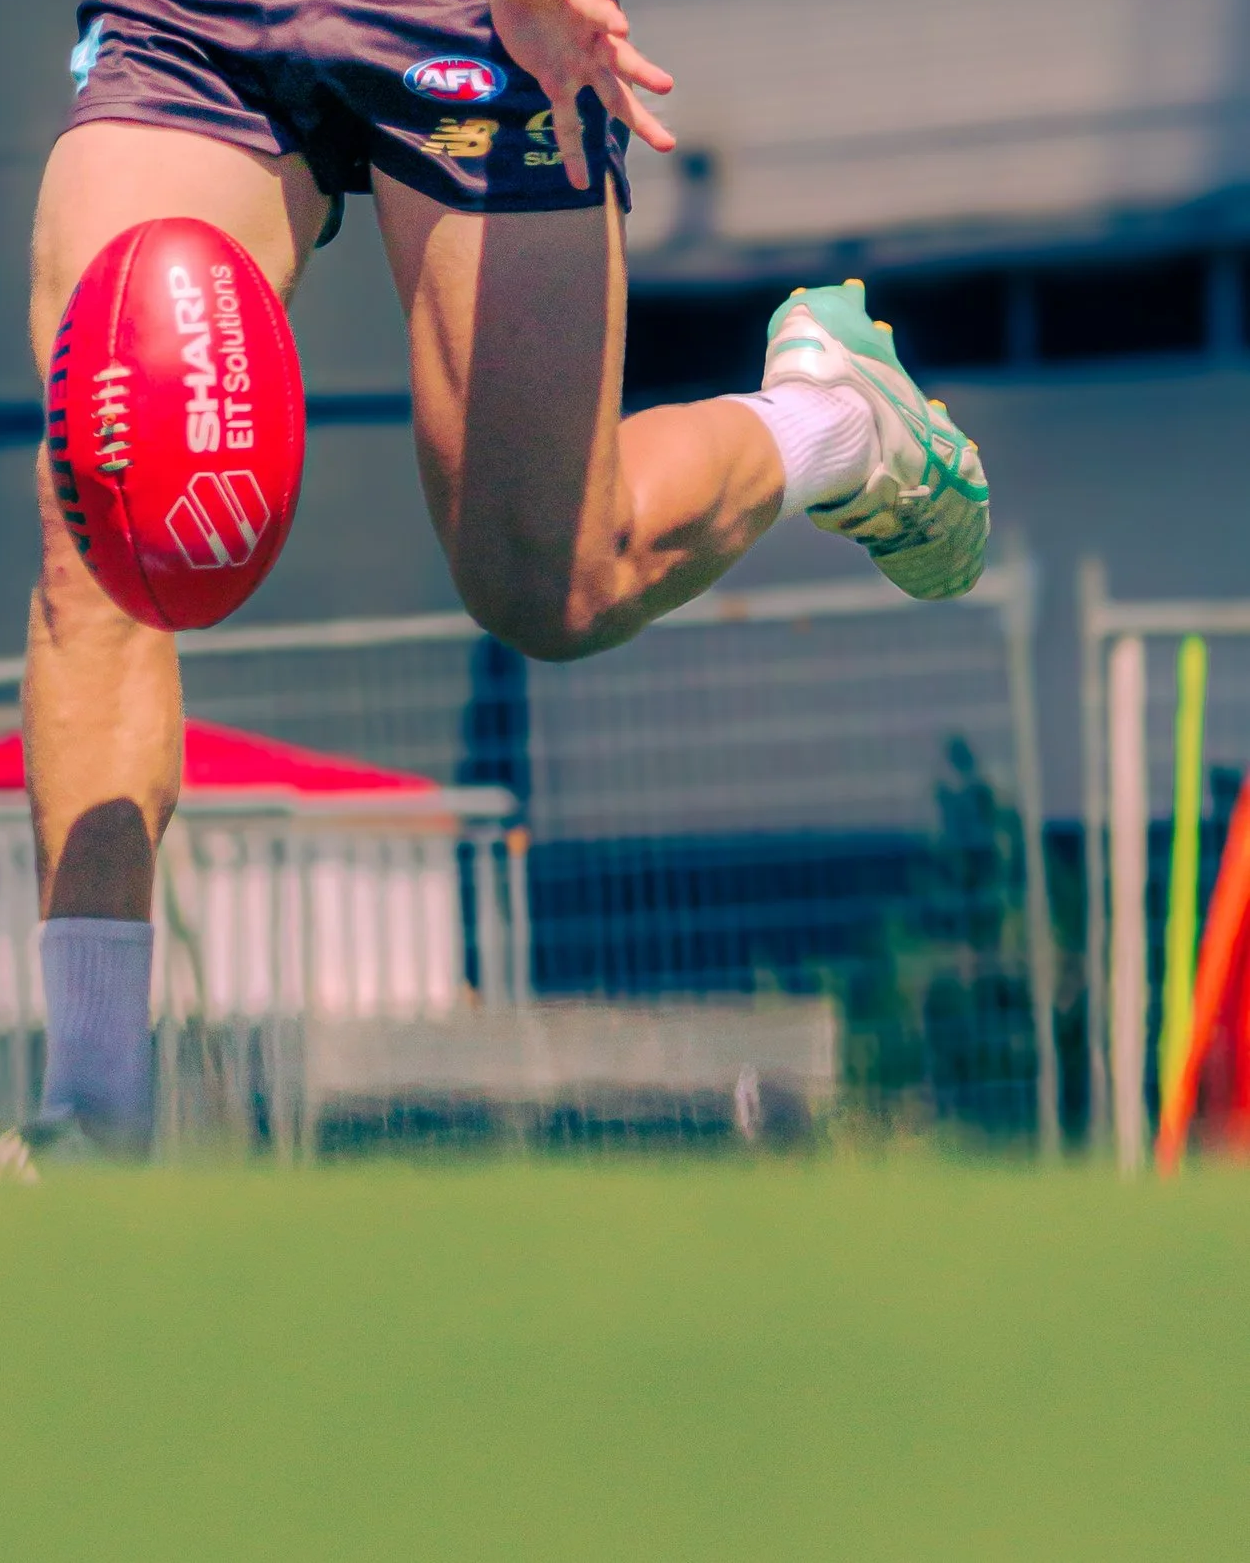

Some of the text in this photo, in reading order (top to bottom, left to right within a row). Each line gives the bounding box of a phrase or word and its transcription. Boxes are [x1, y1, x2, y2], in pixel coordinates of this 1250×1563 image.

[417, 68, 497, 92] AFL
[524, 151, 564, 166] SU
[169, 265, 222, 454] SHARP
[210, 264, 255, 450] EIT Solutions
